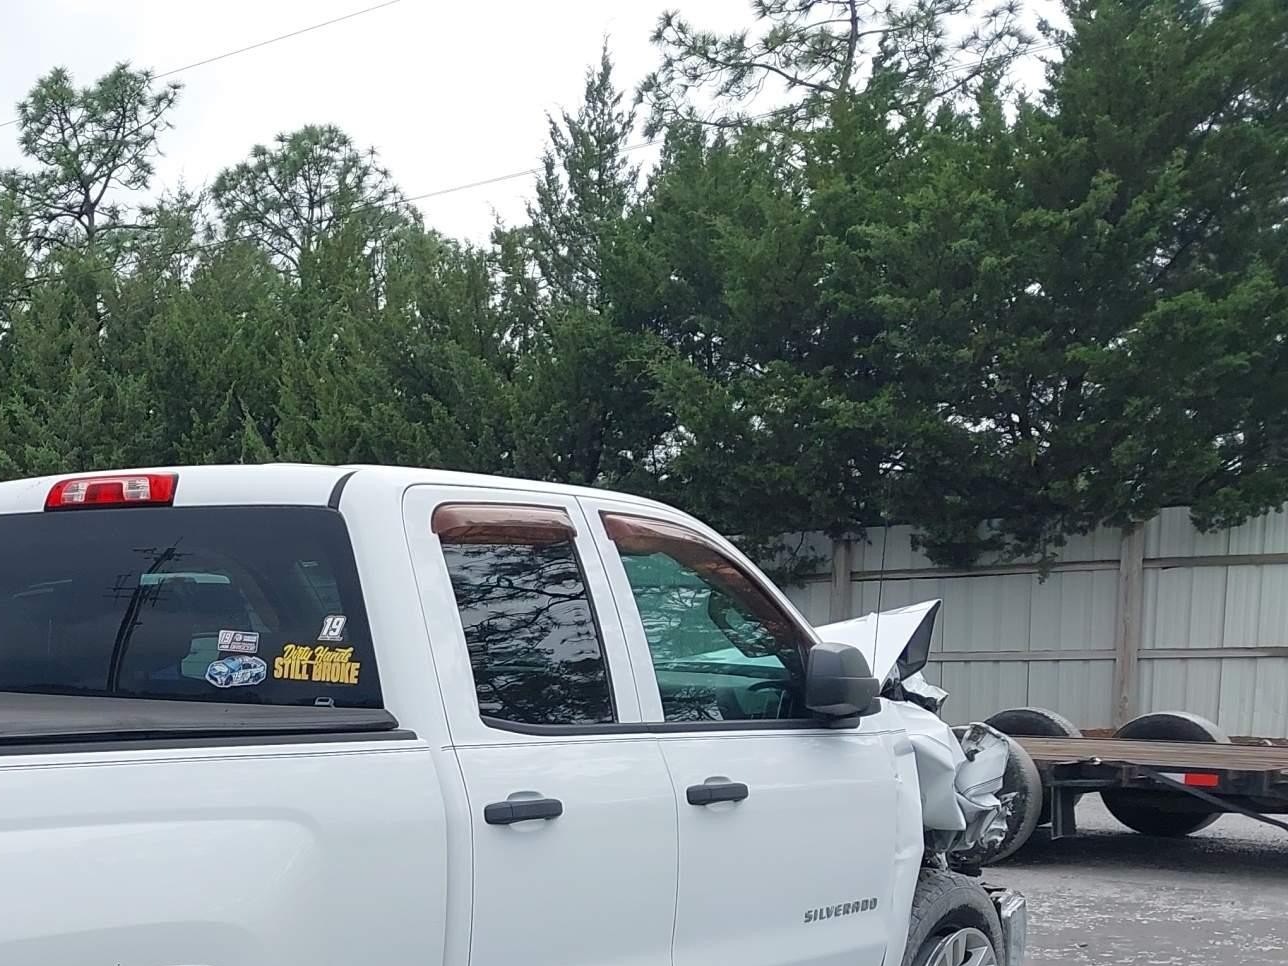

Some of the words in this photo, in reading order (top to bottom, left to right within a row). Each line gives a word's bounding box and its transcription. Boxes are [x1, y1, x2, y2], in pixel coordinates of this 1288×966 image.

[321, 616, 345, 636] 19
[283, 644, 314, 664] Dirty
[314, 645, 354, 664] Hands
[273, 656, 309, 680] STILL
[312, 661, 361, 684] BROKE
[804, 897, 878, 923] SILVERADO
